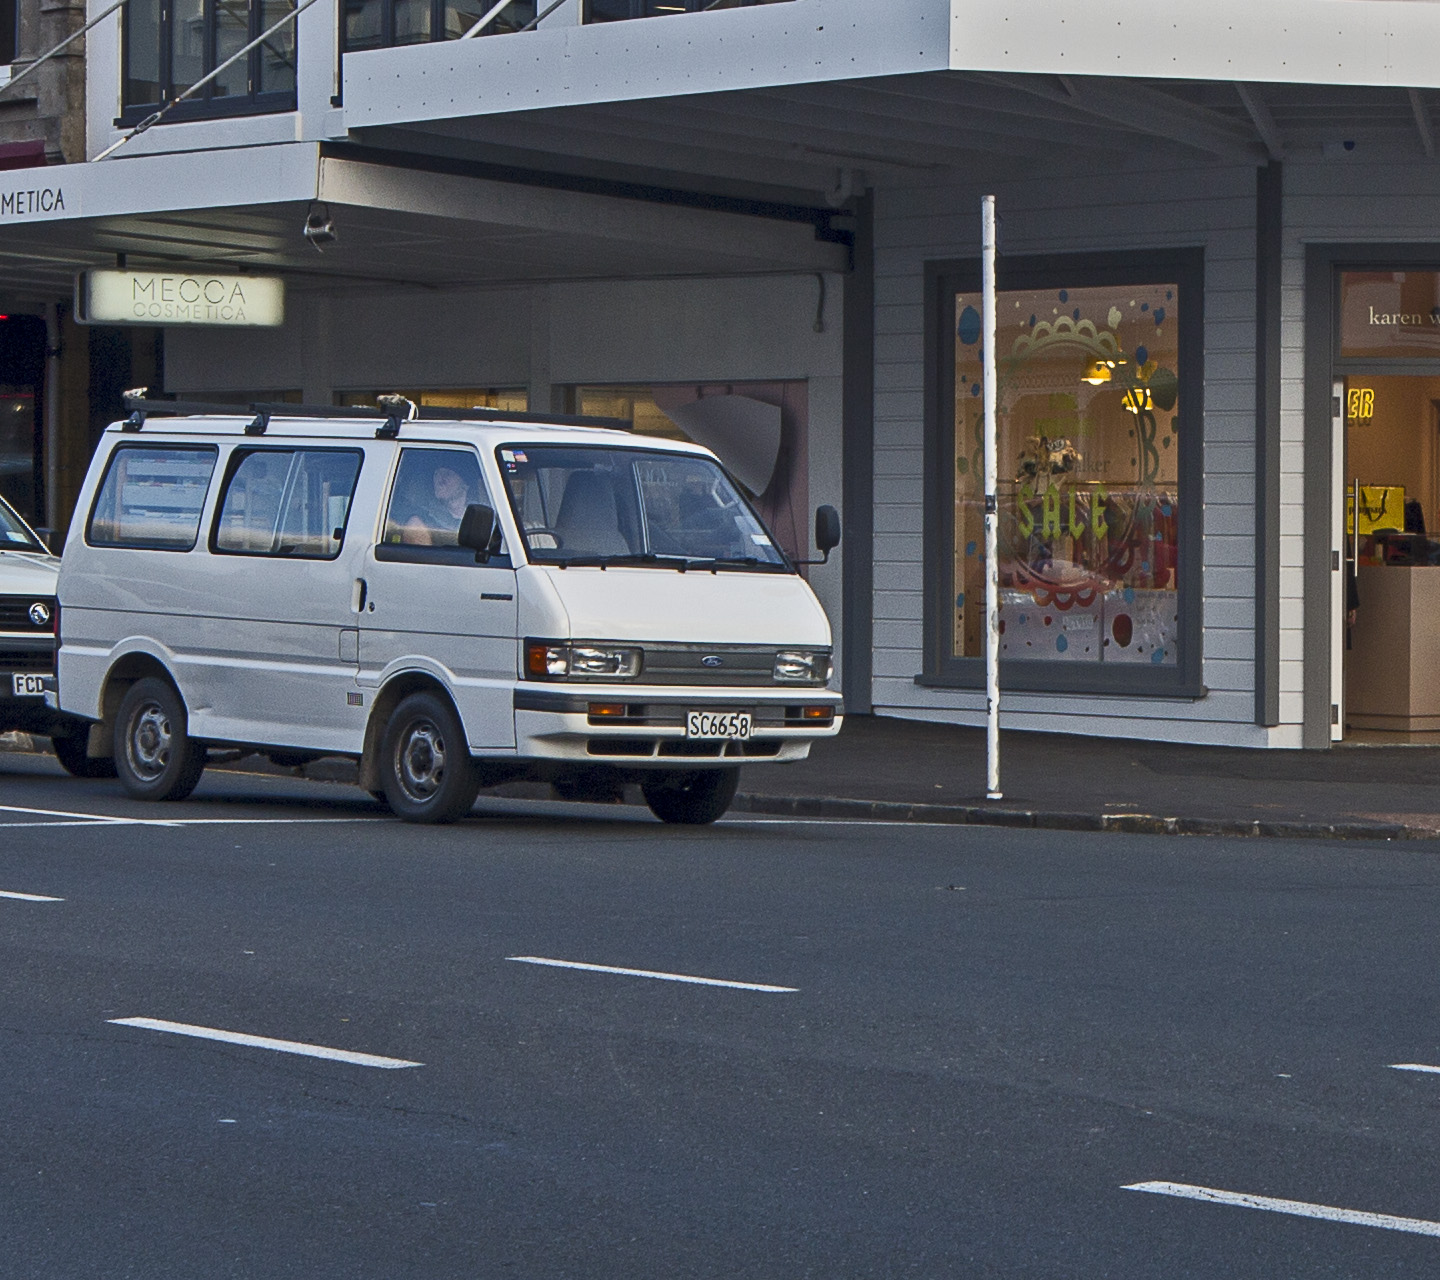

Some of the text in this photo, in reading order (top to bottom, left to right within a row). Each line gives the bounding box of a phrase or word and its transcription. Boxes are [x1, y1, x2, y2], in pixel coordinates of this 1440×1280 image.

[133, 277, 246, 320] MECCA COSMETICA
[1369, 306, 1422, 325] karen
[1018, 483, 1108, 540] SALE
[16, 676, 45, 694] FCD
[690, 715, 749, 737] SC6658
